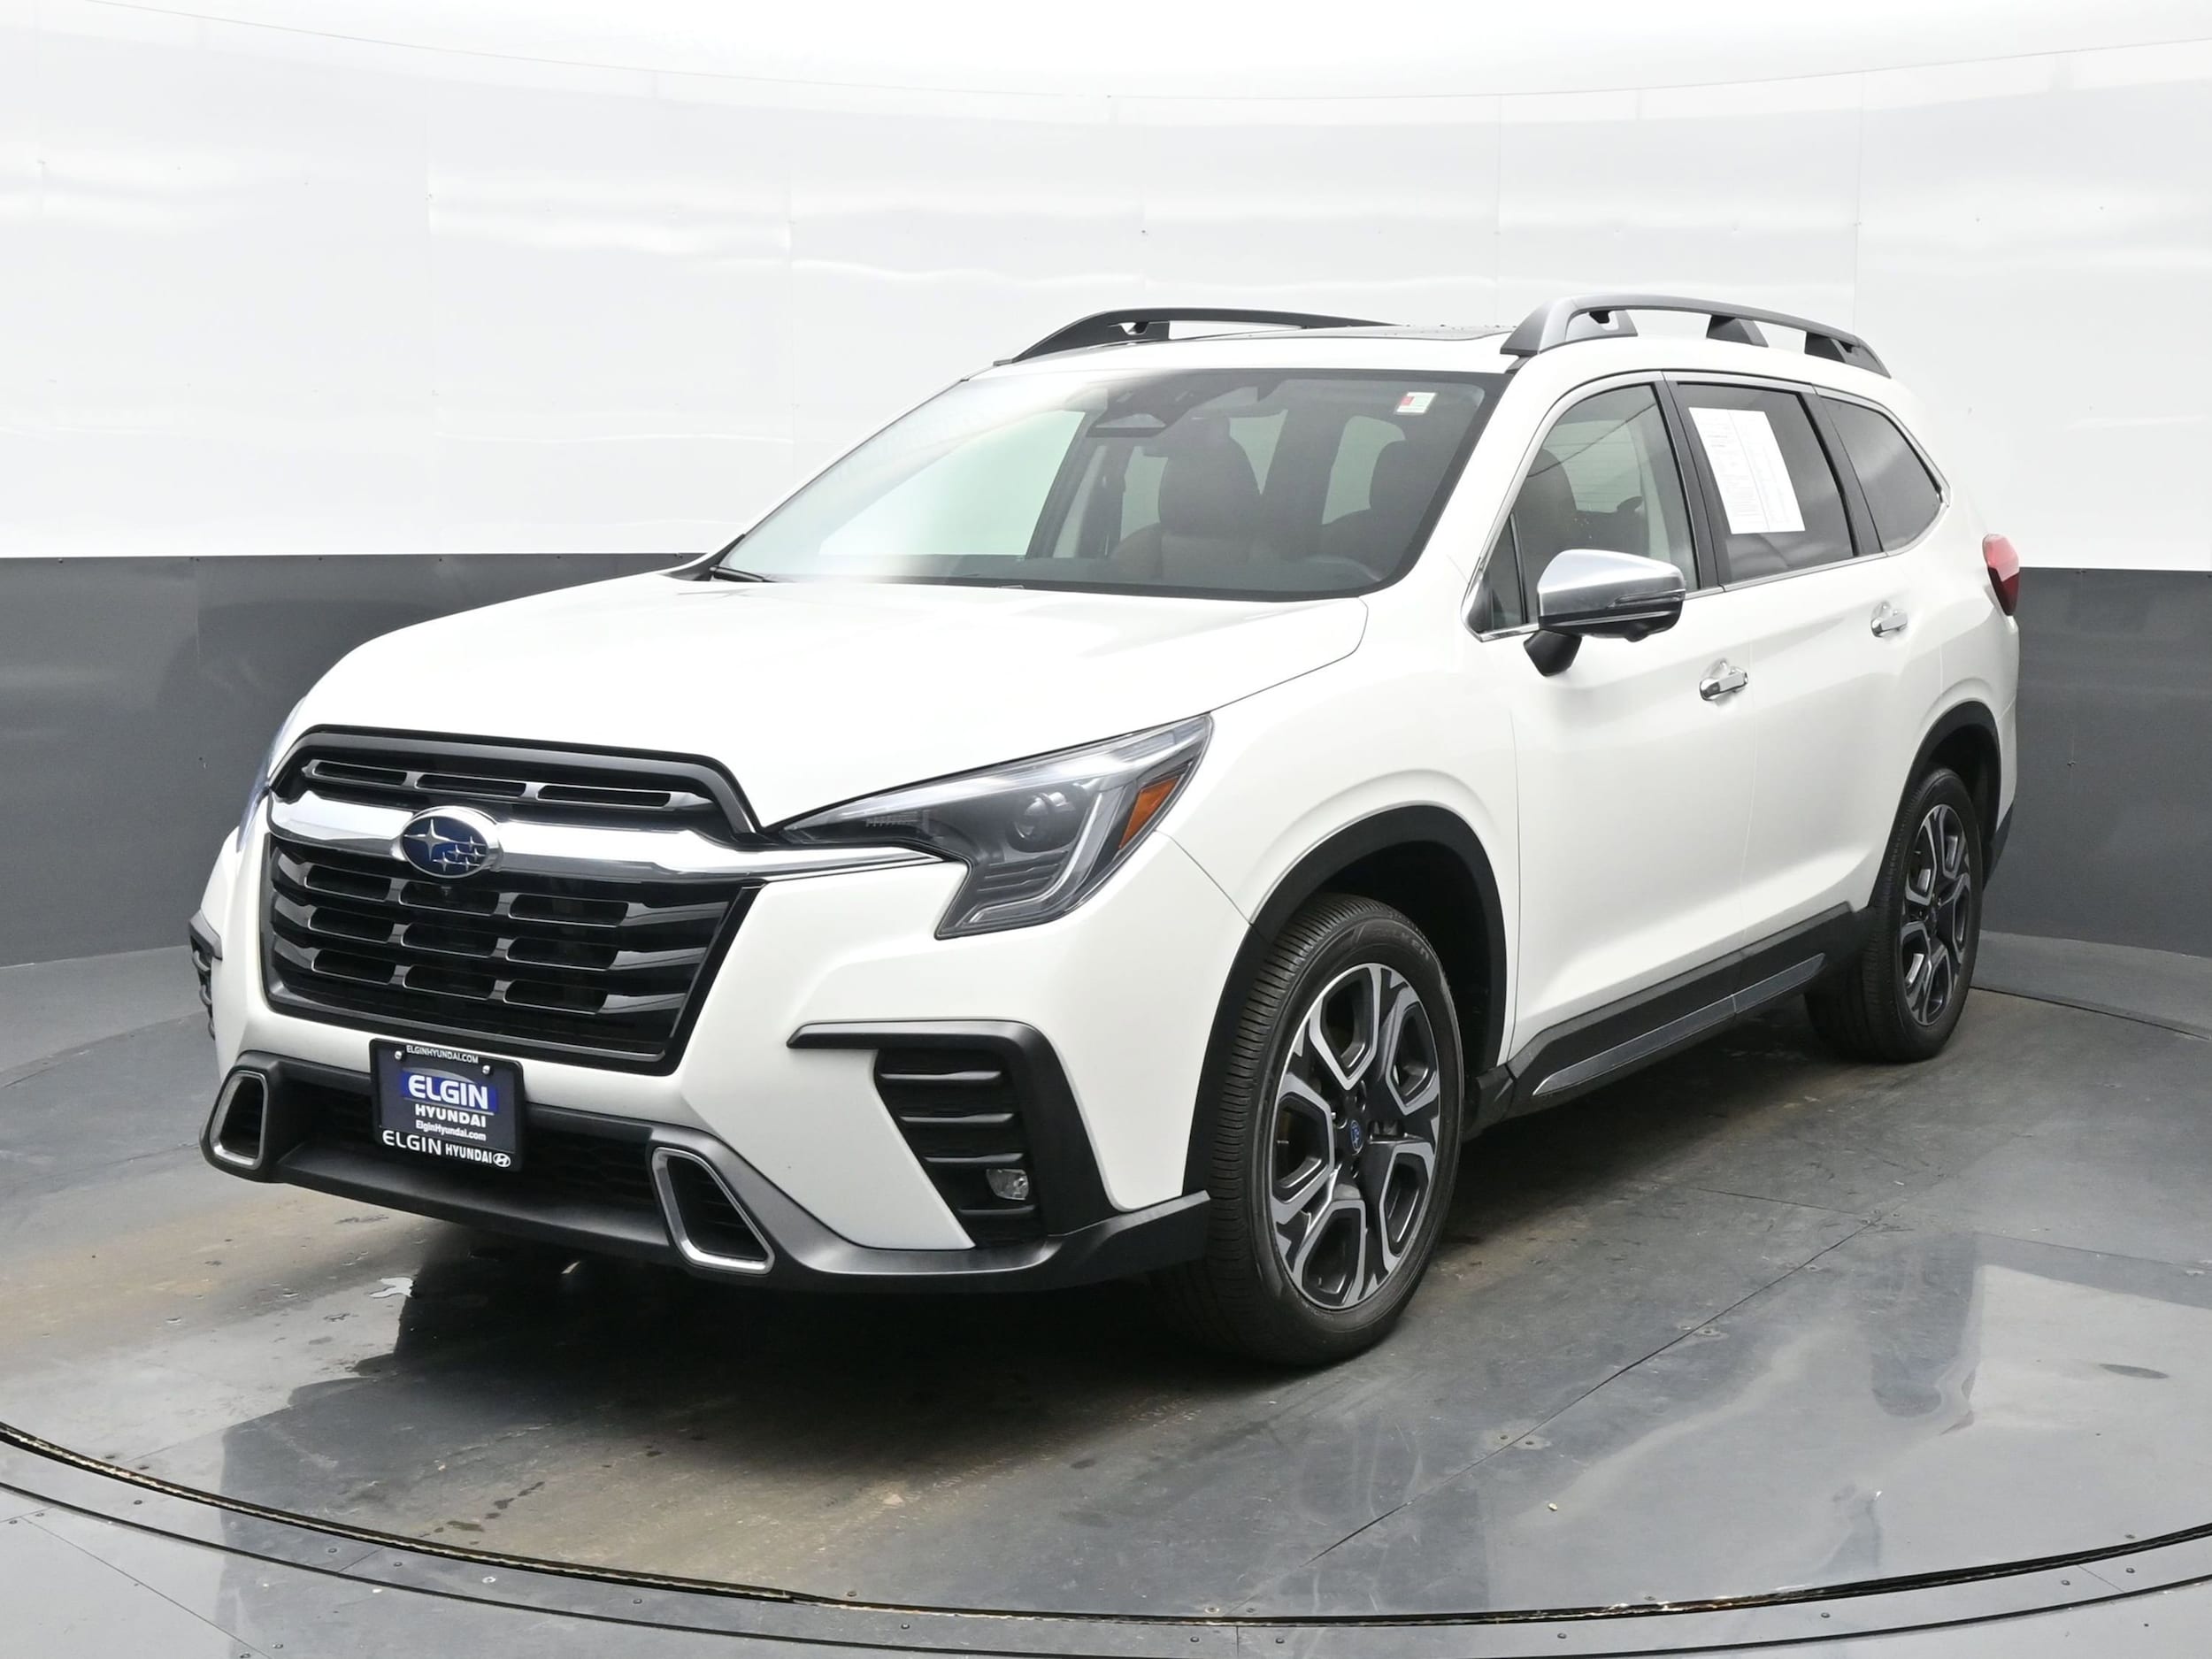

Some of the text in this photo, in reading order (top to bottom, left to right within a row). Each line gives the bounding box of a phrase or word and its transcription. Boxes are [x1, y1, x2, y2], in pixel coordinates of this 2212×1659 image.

[406, 1045, 479, 1064] ELGINHYUNDAI.COM
[408, 1074, 488, 1110] ELGIN
[415, 1104, 487, 1128] HYUNDAI
[415, 1119, 487, 1141] ElginHyundai.com
[382, 1130, 493, 1164] ELGIN HYUNDAI
